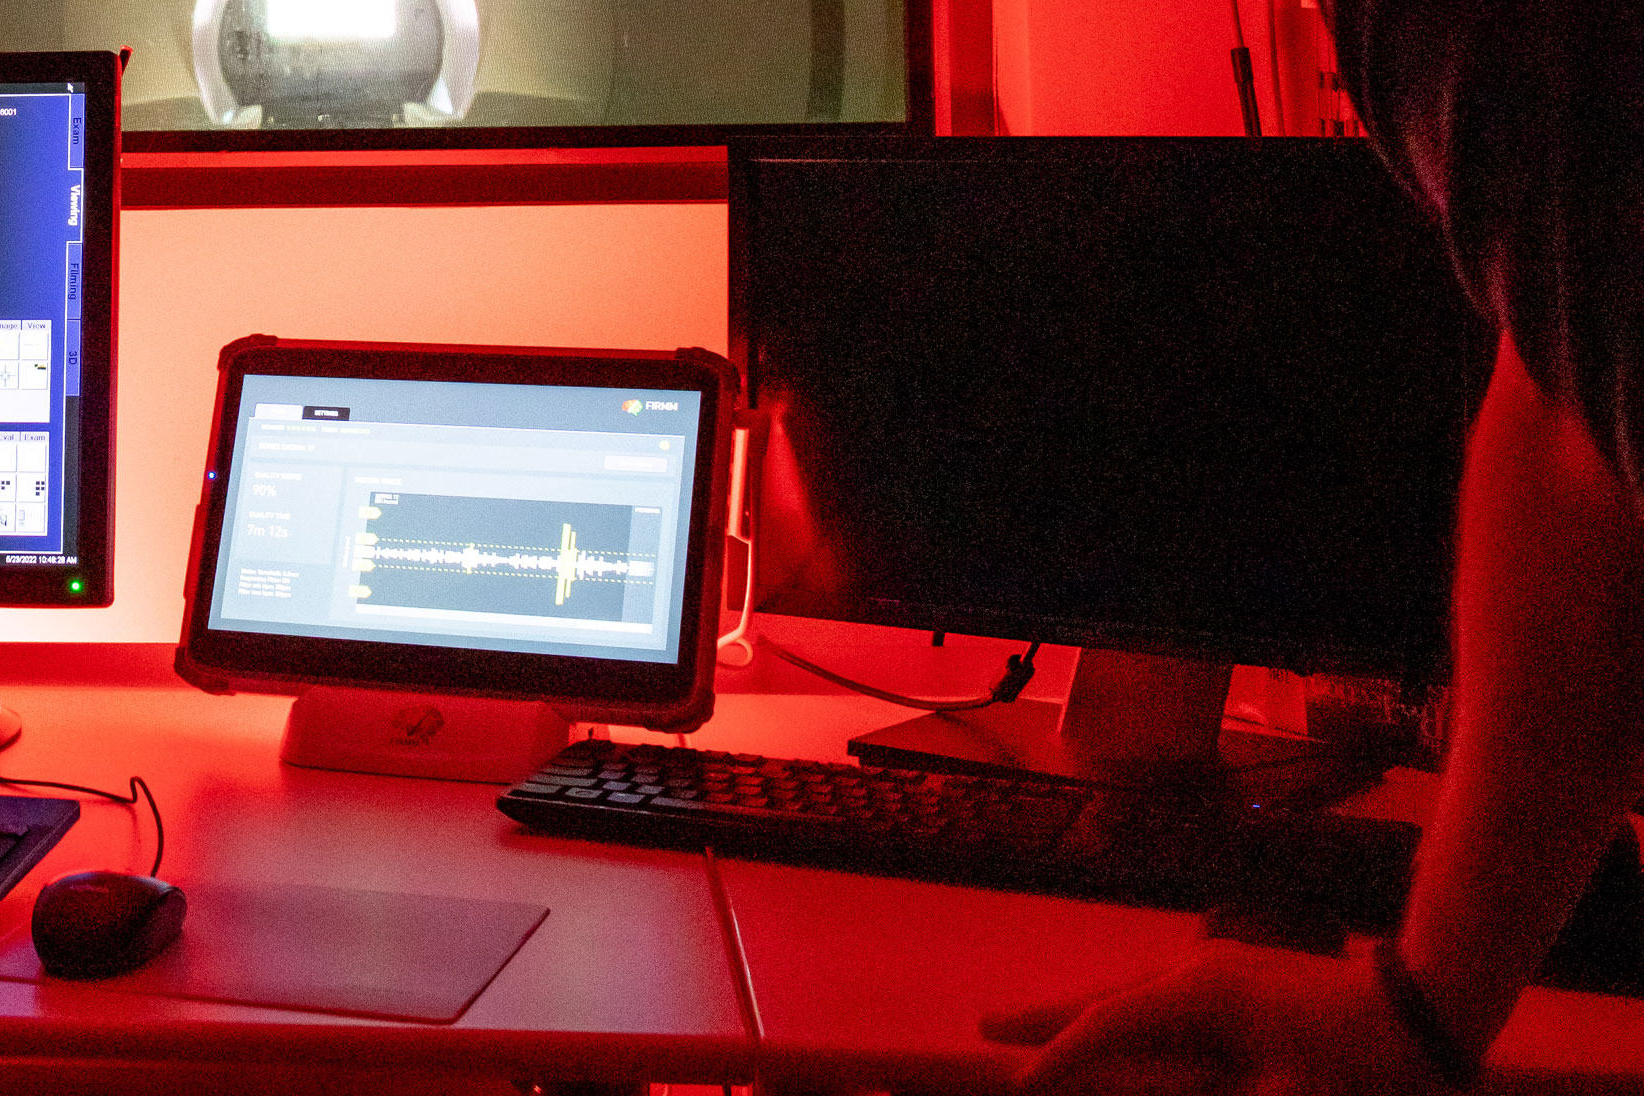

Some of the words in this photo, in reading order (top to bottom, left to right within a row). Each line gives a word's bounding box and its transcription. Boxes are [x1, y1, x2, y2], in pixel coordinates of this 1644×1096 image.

[72, 116, 82, 145] Exam
[67, 184, 81, 226] Viewing
[67, 262, 79, 301] Filming
[27, 322, 46, 330] View
[68, 350, 78, 366] 3D
[252, 484, 276, 497] 90%
[247, 524, 265, 536] 7m
[268, 525, 289, 538] 12s
[66, 556, 78, 564] AM
